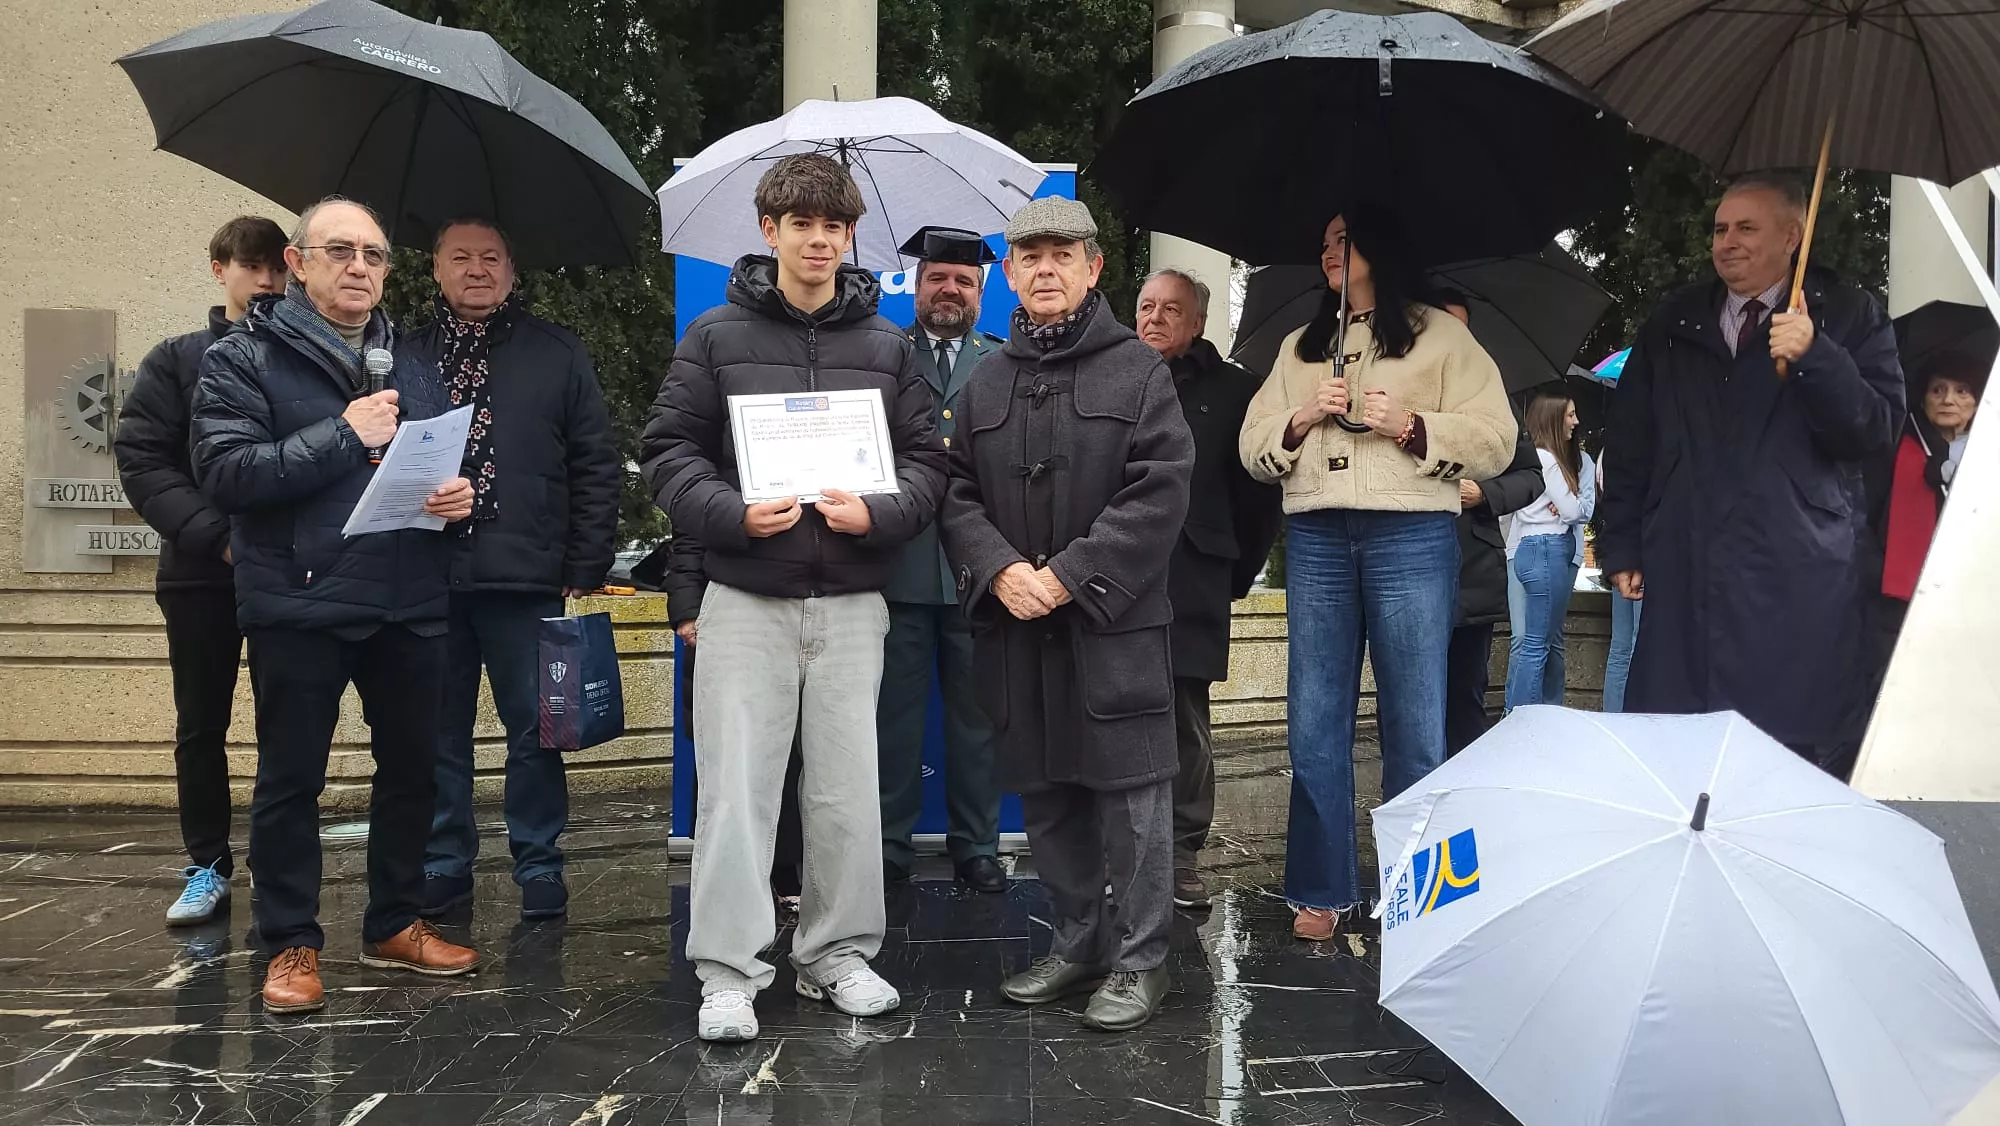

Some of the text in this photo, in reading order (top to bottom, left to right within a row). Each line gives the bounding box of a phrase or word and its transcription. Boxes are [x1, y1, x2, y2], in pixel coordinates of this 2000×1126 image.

[352, 37, 428, 64] Automóviles
[360, 46, 442, 74] CABRERO
[48, 483, 126, 502] ROTARY
[1395, 866, 1409, 926] EALE
